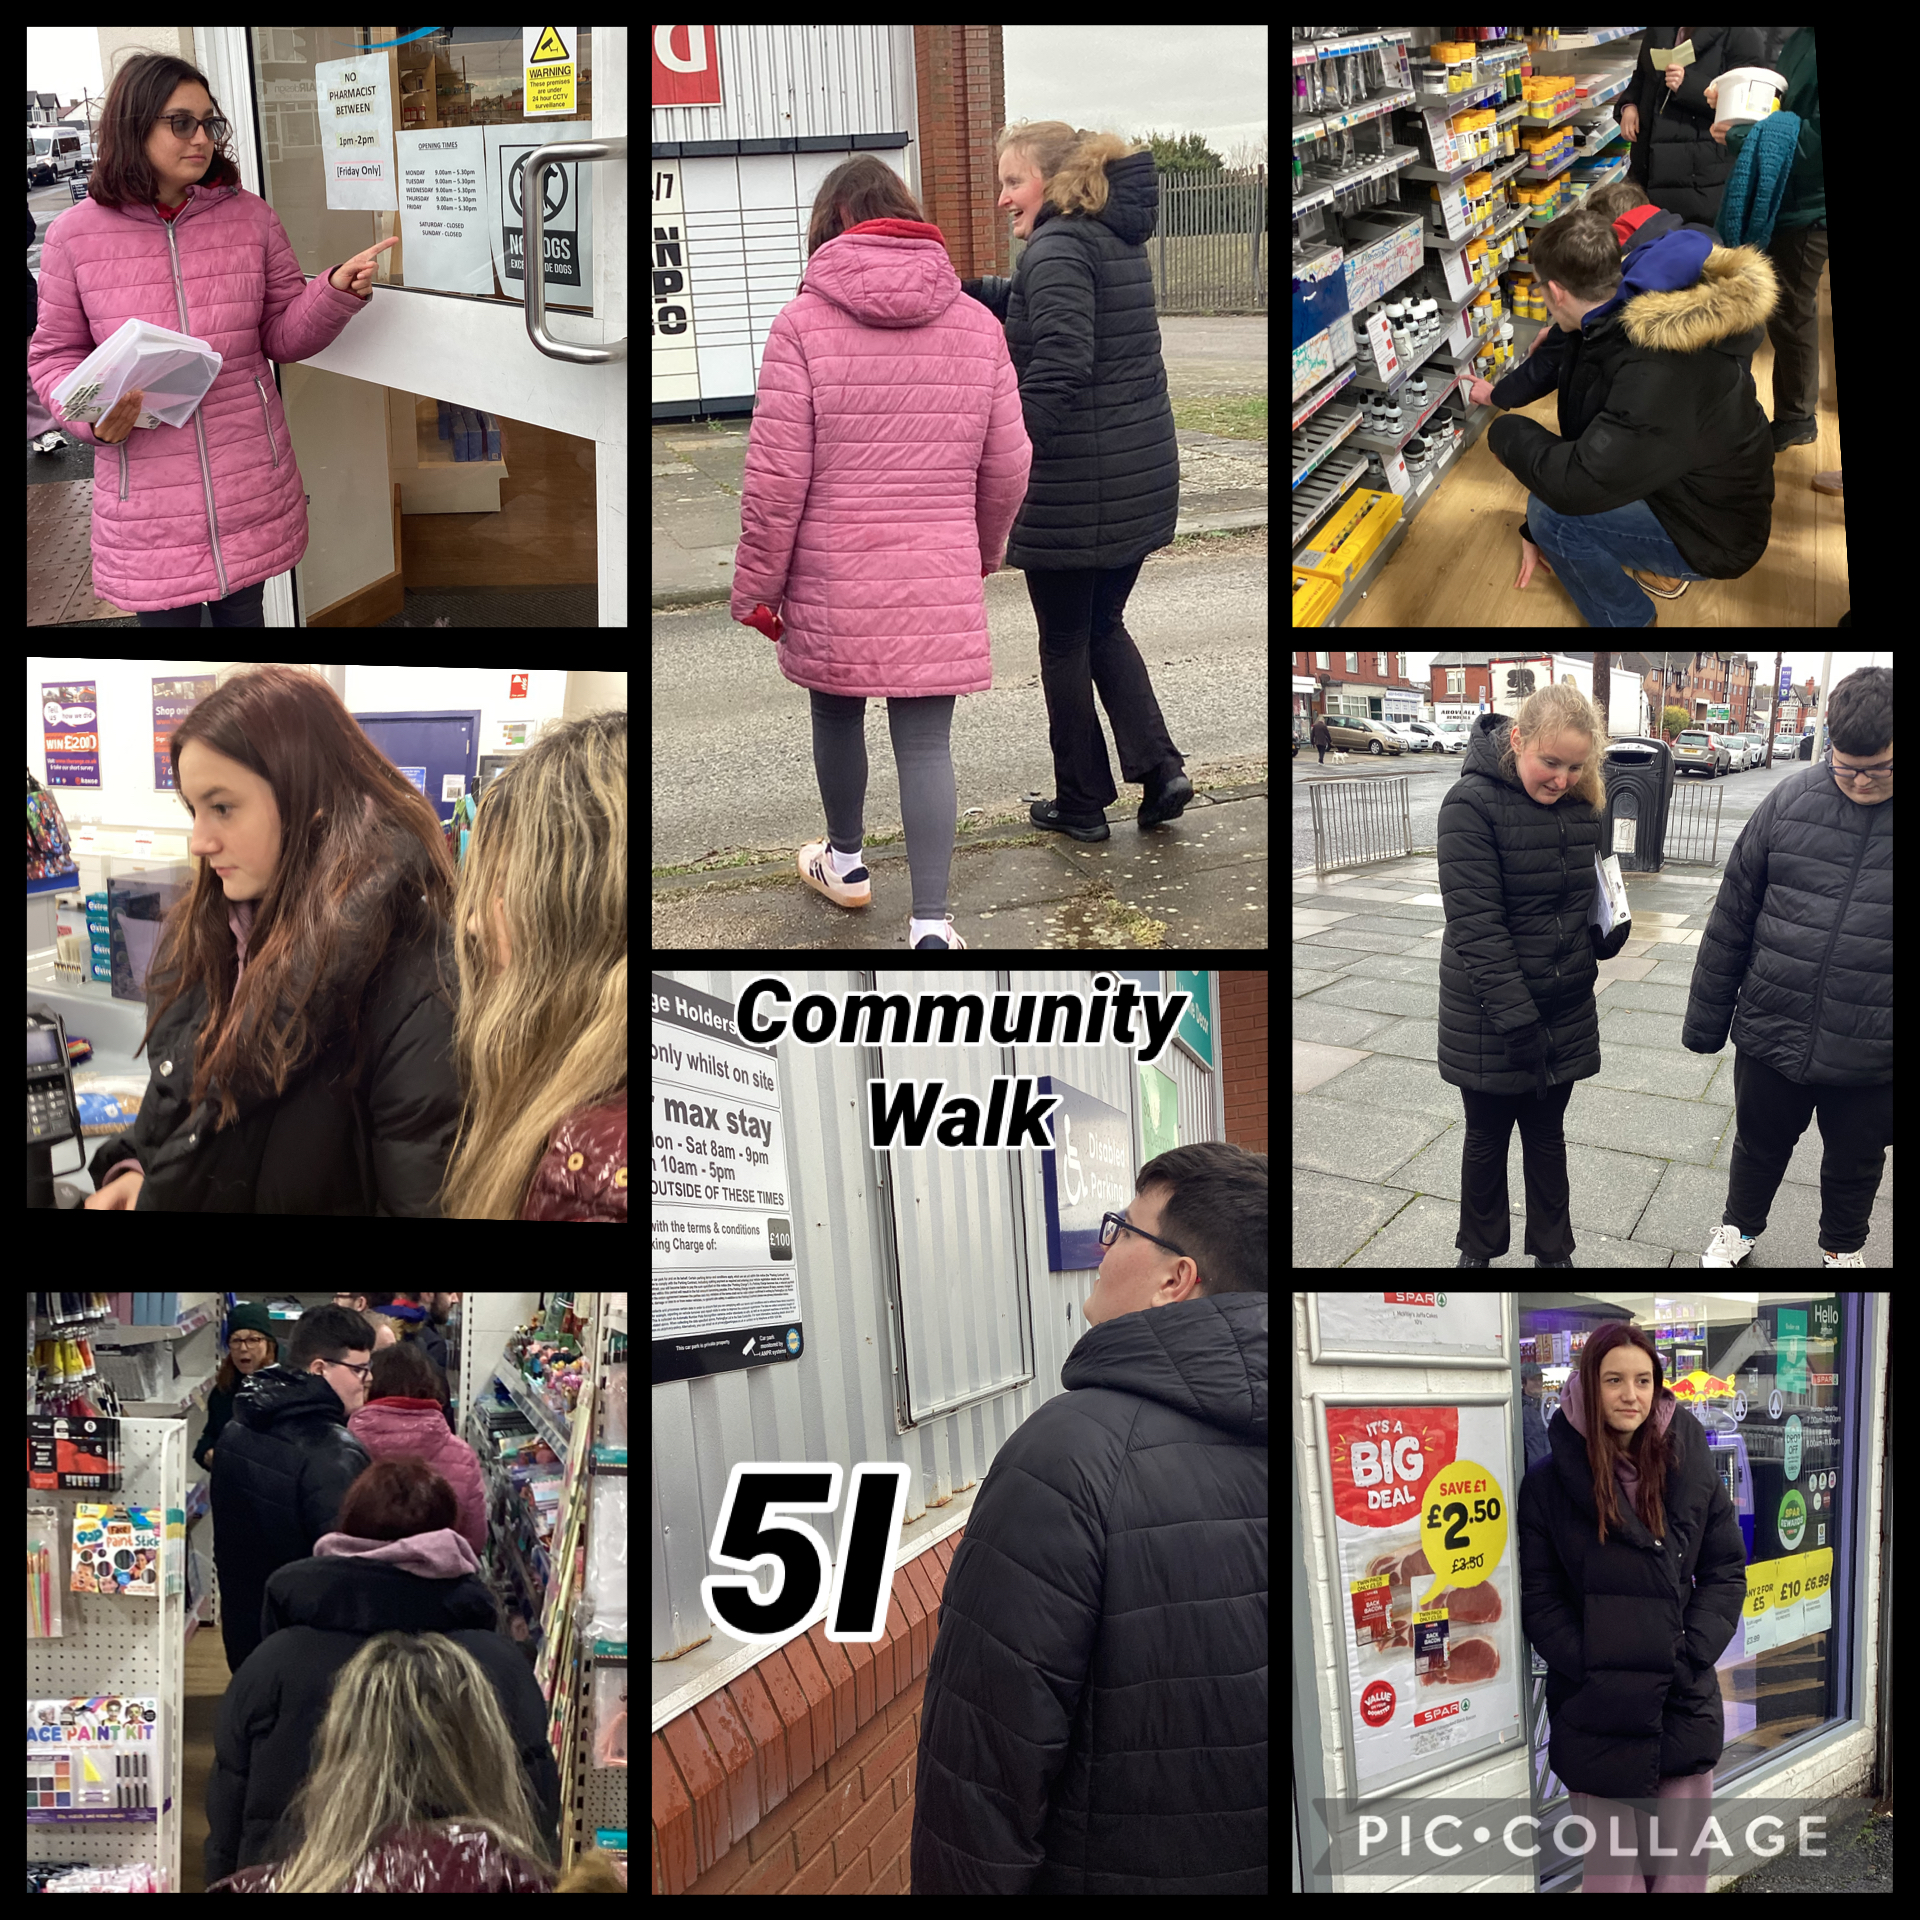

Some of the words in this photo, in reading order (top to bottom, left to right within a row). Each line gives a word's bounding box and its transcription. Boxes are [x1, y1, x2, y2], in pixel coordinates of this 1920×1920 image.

[344, 72, 357, 82] NO
[529, 66, 571, 78] WARNING
[547, 79, 570, 87] premises
[329, 86, 376, 100] PHARMACIST
[336, 103, 370, 115] BETWEEN
[339, 137, 353, 146] 1pm
[544, 237, 571, 260] OGS
[554, 263, 572, 275] DOGS
[155, 706, 175, 717] Shop
[46, 739, 64, 750] WIN
[162, 767, 167, 775] 7
[675, 996, 737, 1035] Holders
[686, 1052, 730, 1080] whilst
[733, 1067, 749, 1085] on
[752, 1070, 774, 1092] site
[664, 1097, 720, 1131] max
[726, 1108, 772, 1148] stay
[686, 1136, 707, 1156] Sat
[710, 1140, 735, 1160] 8am
[745, 1146, 769, 1167] 9pm
[1088, 1131, 1125, 1168] Disabled
[660, 1155, 698, 1176] 10am
[709, 1162, 736, 1183] 5pm
[705, 1185, 719, 1200] OF
[722, 1187, 755, 1203] THESE
[757, 1191, 784, 1206] TIMES
[1090, 1172, 1124, 1208] Parking
[671, 1220, 685, 1233] the
[687, 1221, 711, 1234] terms
[713, 1222, 720, 1234] &
[721, 1224, 760, 1235] conditions
[673, 1238, 704, 1253] Charge
[706, 1238, 717, 1250] of:
[769, 1232, 790, 1247] £100
[1396, 1292, 1435, 1304] SPAR
[1814, 1304, 1839, 1324] Hello
[1817, 1374, 1833, 1384] SPAR
[87, 1422, 94, 1431] 6
[1366, 1419, 1390, 1437] IT'S
[1393, 1420, 1403, 1434] A
[95, 1445, 102, 1453] 6
[1351, 1436, 1424, 1487] BIG
[1439, 1480, 1472, 1496] SAVE
[1474, 1479, 1487, 1493] £1
[1367, 1485, 1416, 1510] DEAL
[1785, 1507, 1800, 1518] SPAR
[1427, 1498, 1501, 1550] £2.50
[1780, 1515, 1804, 1528] REWARDS
[1451, 1553, 1484, 1574] £3.50
[1757, 1586, 1761, 1595] 2
[1761, 1583, 1774, 1593] FOR
[1780, 1579, 1801, 1601] £10
[1804, 1573, 1830, 1592] £6.99
[1364, 1606, 1383, 1614] BACON
[1366, 1600, 1380, 1608] BACK
[1753, 1596, 1765, 1612] £5
[1364, 1692, 1392, 1706] VALUE
[1367, 1705, 1390, 1716] DOORSTEP
[1424, 1703, 1459, 1722] SPAR
[67, 1725, 121, 1741] PAINT
[126, 1724, 154, 1740] KIT
